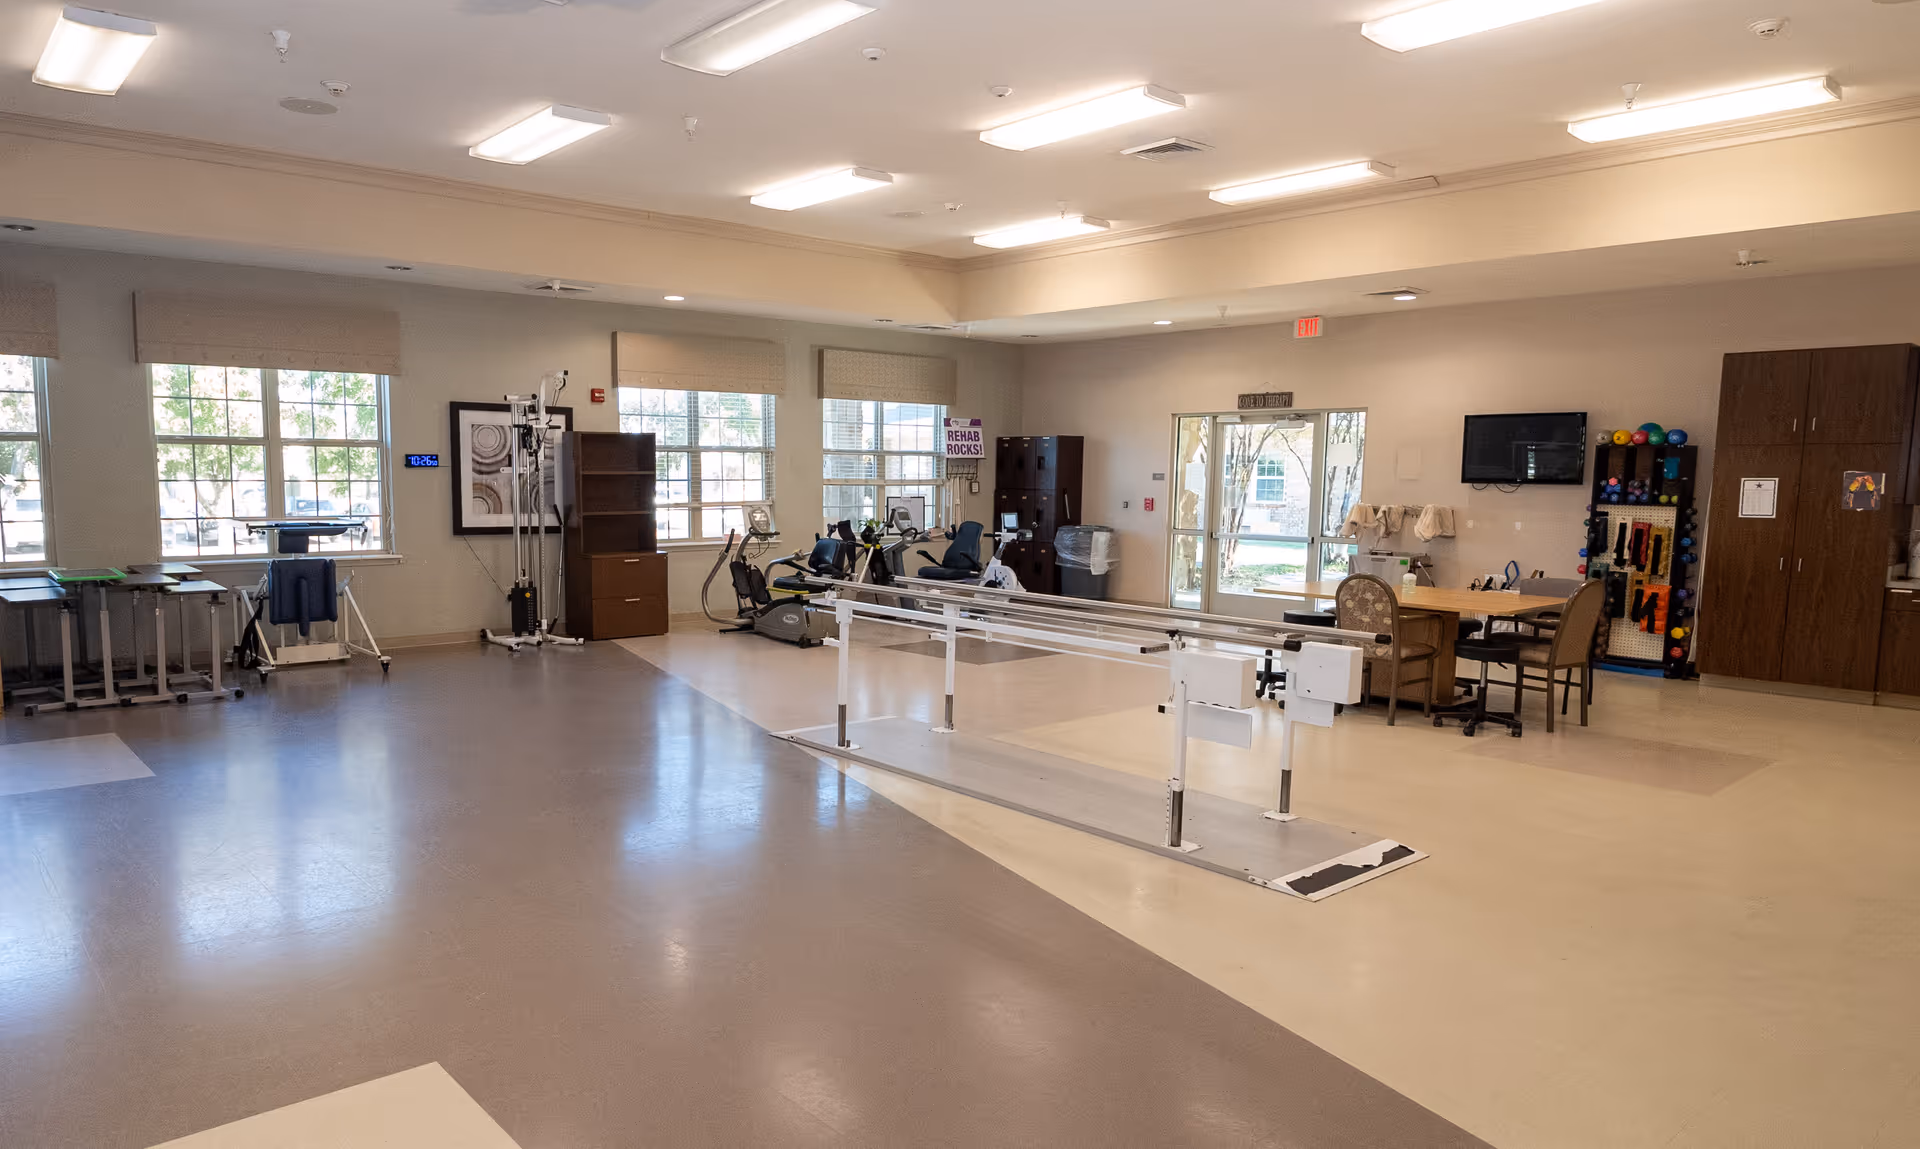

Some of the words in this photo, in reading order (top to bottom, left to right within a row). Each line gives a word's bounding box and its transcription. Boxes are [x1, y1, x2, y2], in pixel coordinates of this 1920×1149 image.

[1298, 318, 1319, 337] EXIT
[1256, 396, 1264, 407] TO
[947, 430, 980, 442] REHAB
[947, 443, 983, 455] ROCKS!
[411, 455, 431, 465] 10:26
